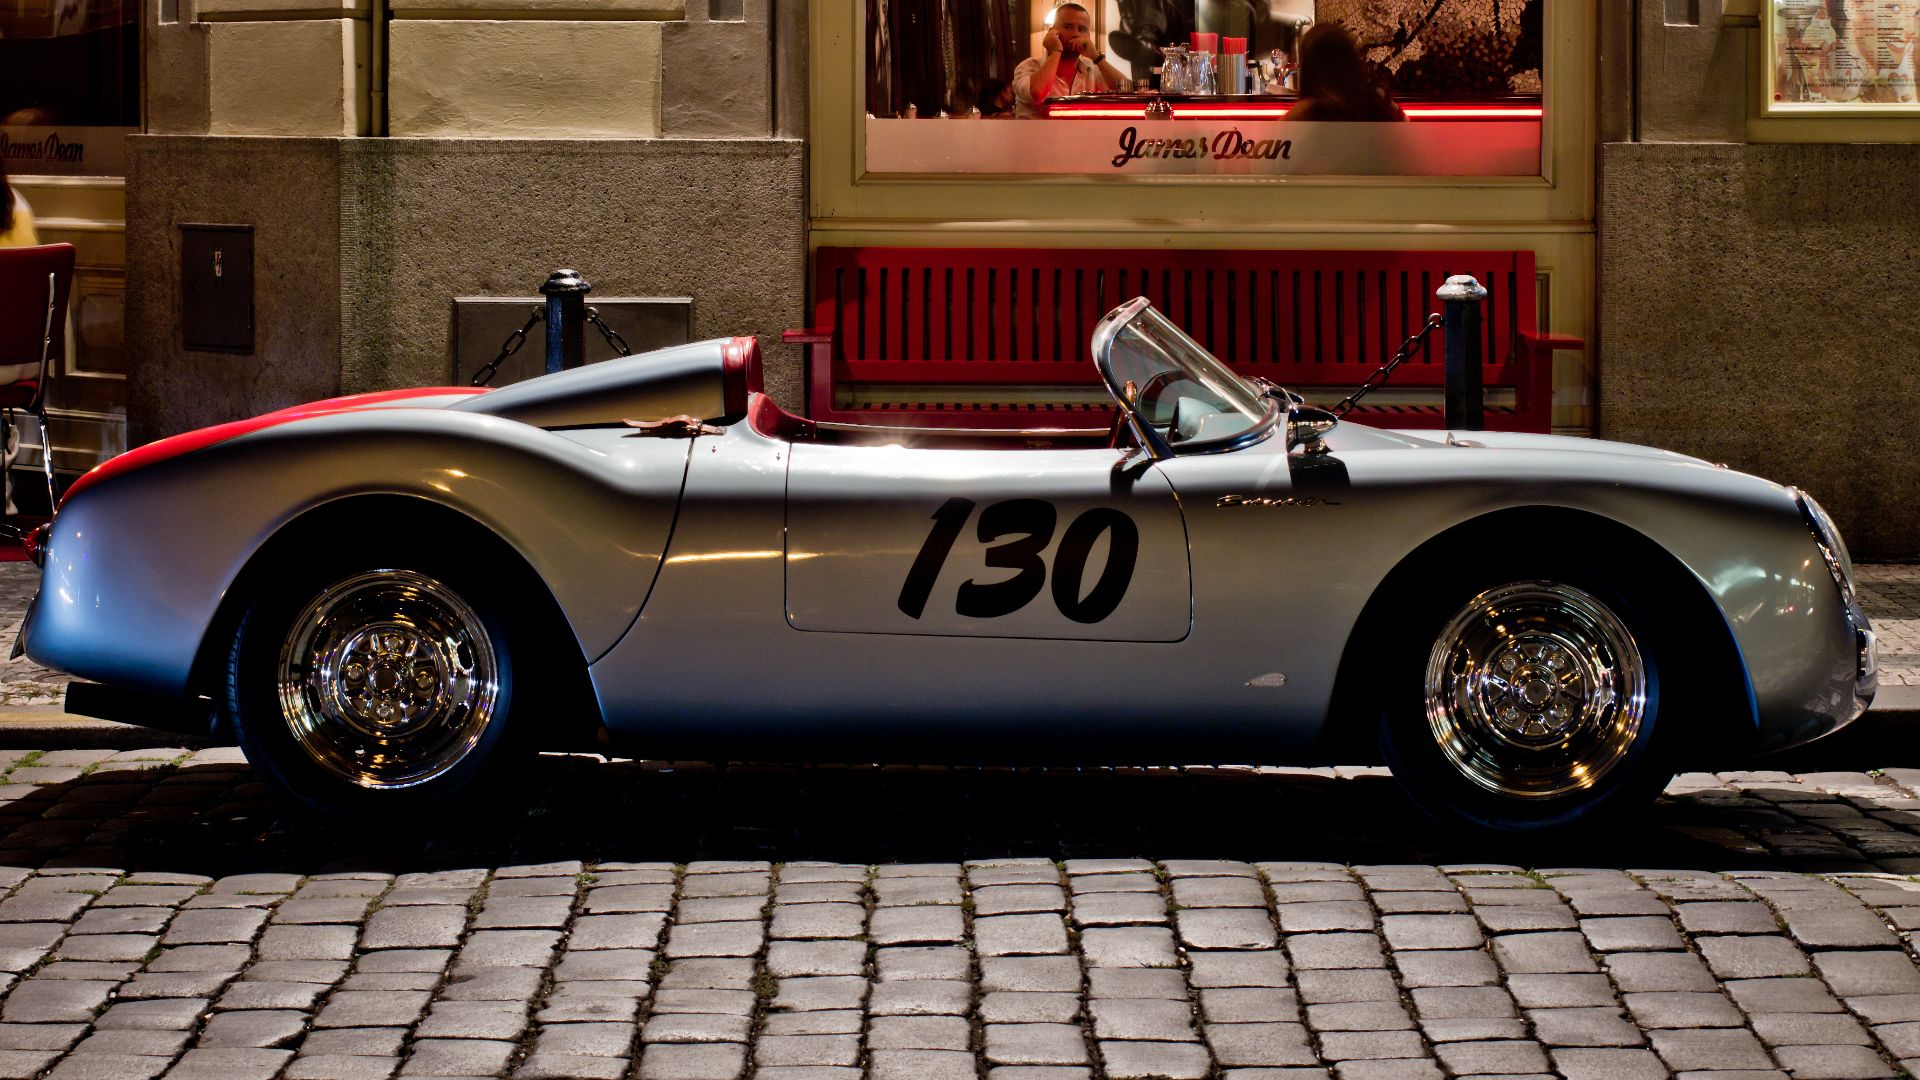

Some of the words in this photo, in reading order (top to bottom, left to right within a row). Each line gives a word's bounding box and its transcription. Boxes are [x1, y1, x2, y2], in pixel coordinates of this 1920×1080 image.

[44, 132, 84, 161] Dean
[1111, 126, 1208, 167] James
[1211, 127, 1292, 160] Dean
[897, 496, 1139, 624] 130
